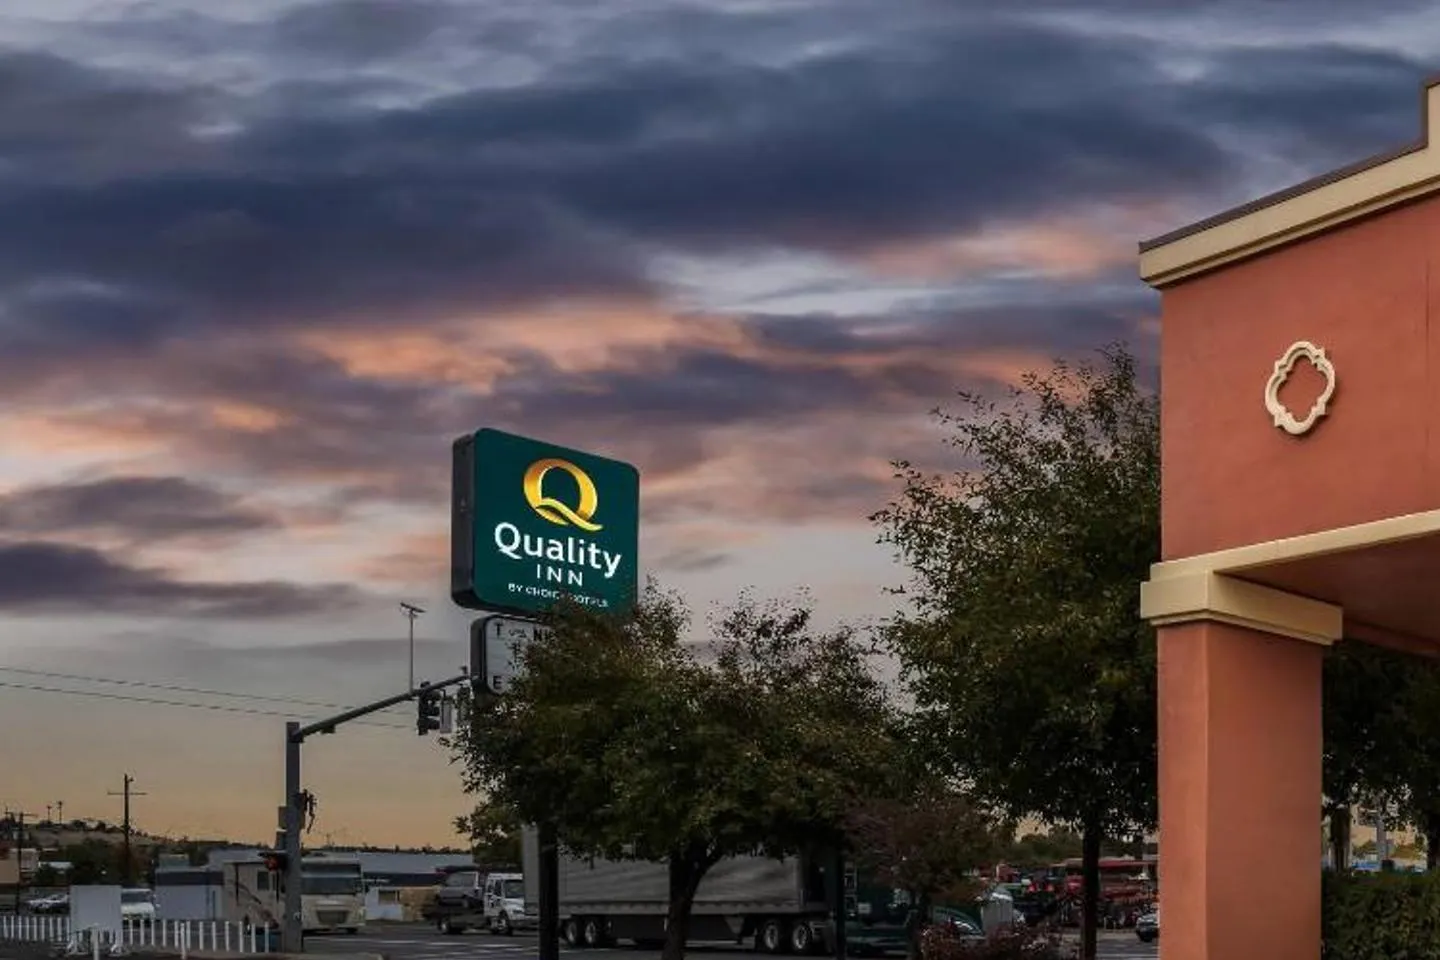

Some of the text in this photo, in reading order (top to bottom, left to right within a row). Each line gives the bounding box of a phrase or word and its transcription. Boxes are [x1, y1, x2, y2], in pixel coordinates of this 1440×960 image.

[524, 458, 603, 532] Q
[494, 522, 622, 578] Quality
[507, 583, 524, 593] BY
[525, 586, 566, 600] CHOIC
[536, 564, 584, 587] INN
